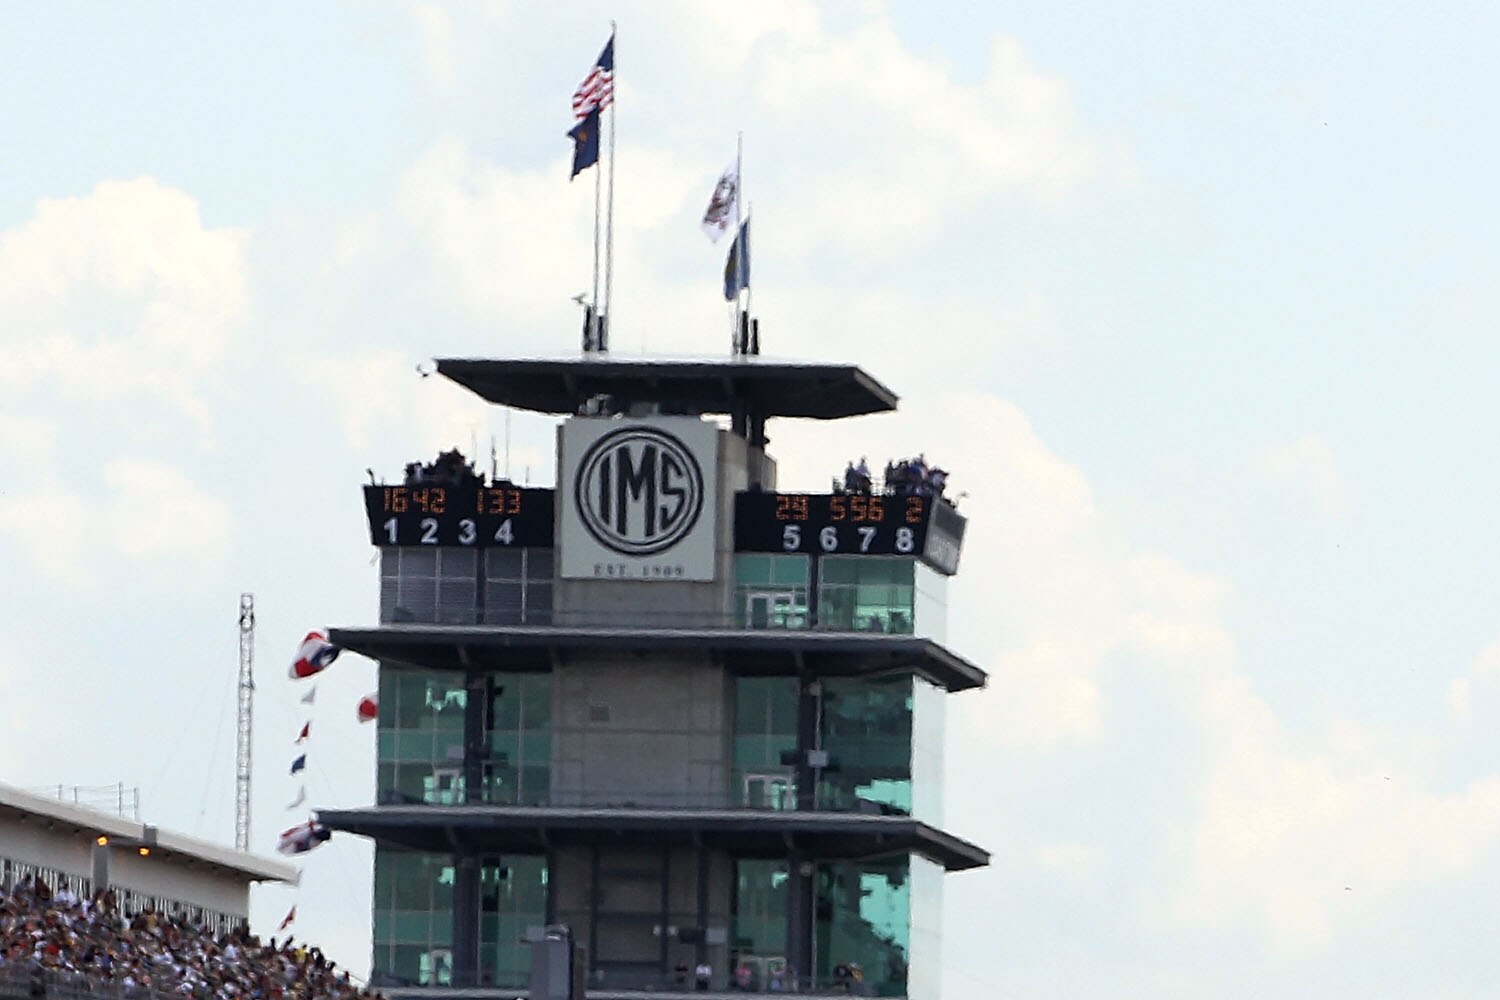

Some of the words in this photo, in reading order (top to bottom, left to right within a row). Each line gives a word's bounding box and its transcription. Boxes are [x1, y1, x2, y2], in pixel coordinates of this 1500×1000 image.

[412, 488, 446, 514] 42
[600, 445, 687, 538] IMS
[384, 517, 398, 545] 1
[420, 517, 440, 545] 2
[457, 518, 478, 545] 3
[494, 518, 515, 545] 4
[782, 524, 802, 550] 5
[819, 526, 839, 552] 6
[857, 526, 878, 552] 7
[895, 526, 914, 553] 8
